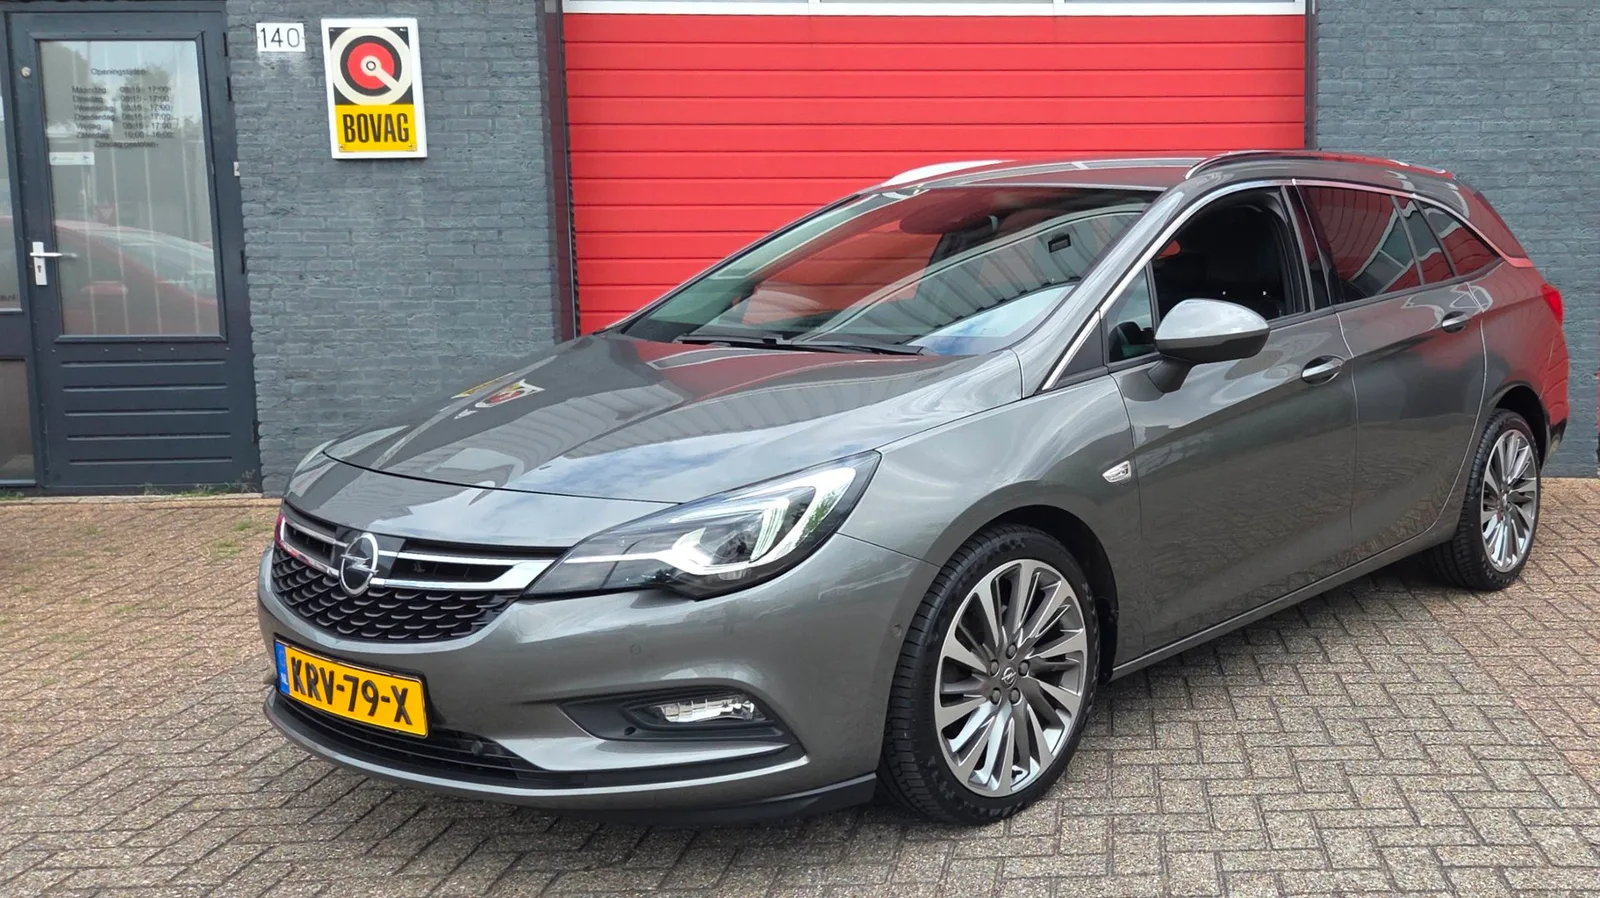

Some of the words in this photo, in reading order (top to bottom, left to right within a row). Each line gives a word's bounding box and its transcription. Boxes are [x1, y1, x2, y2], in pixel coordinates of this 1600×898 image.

[260, 27, 300, 48] 140
[343, 113, 409, 143] BOVAG
[291, 656, 412, 726] KRV-79-X
